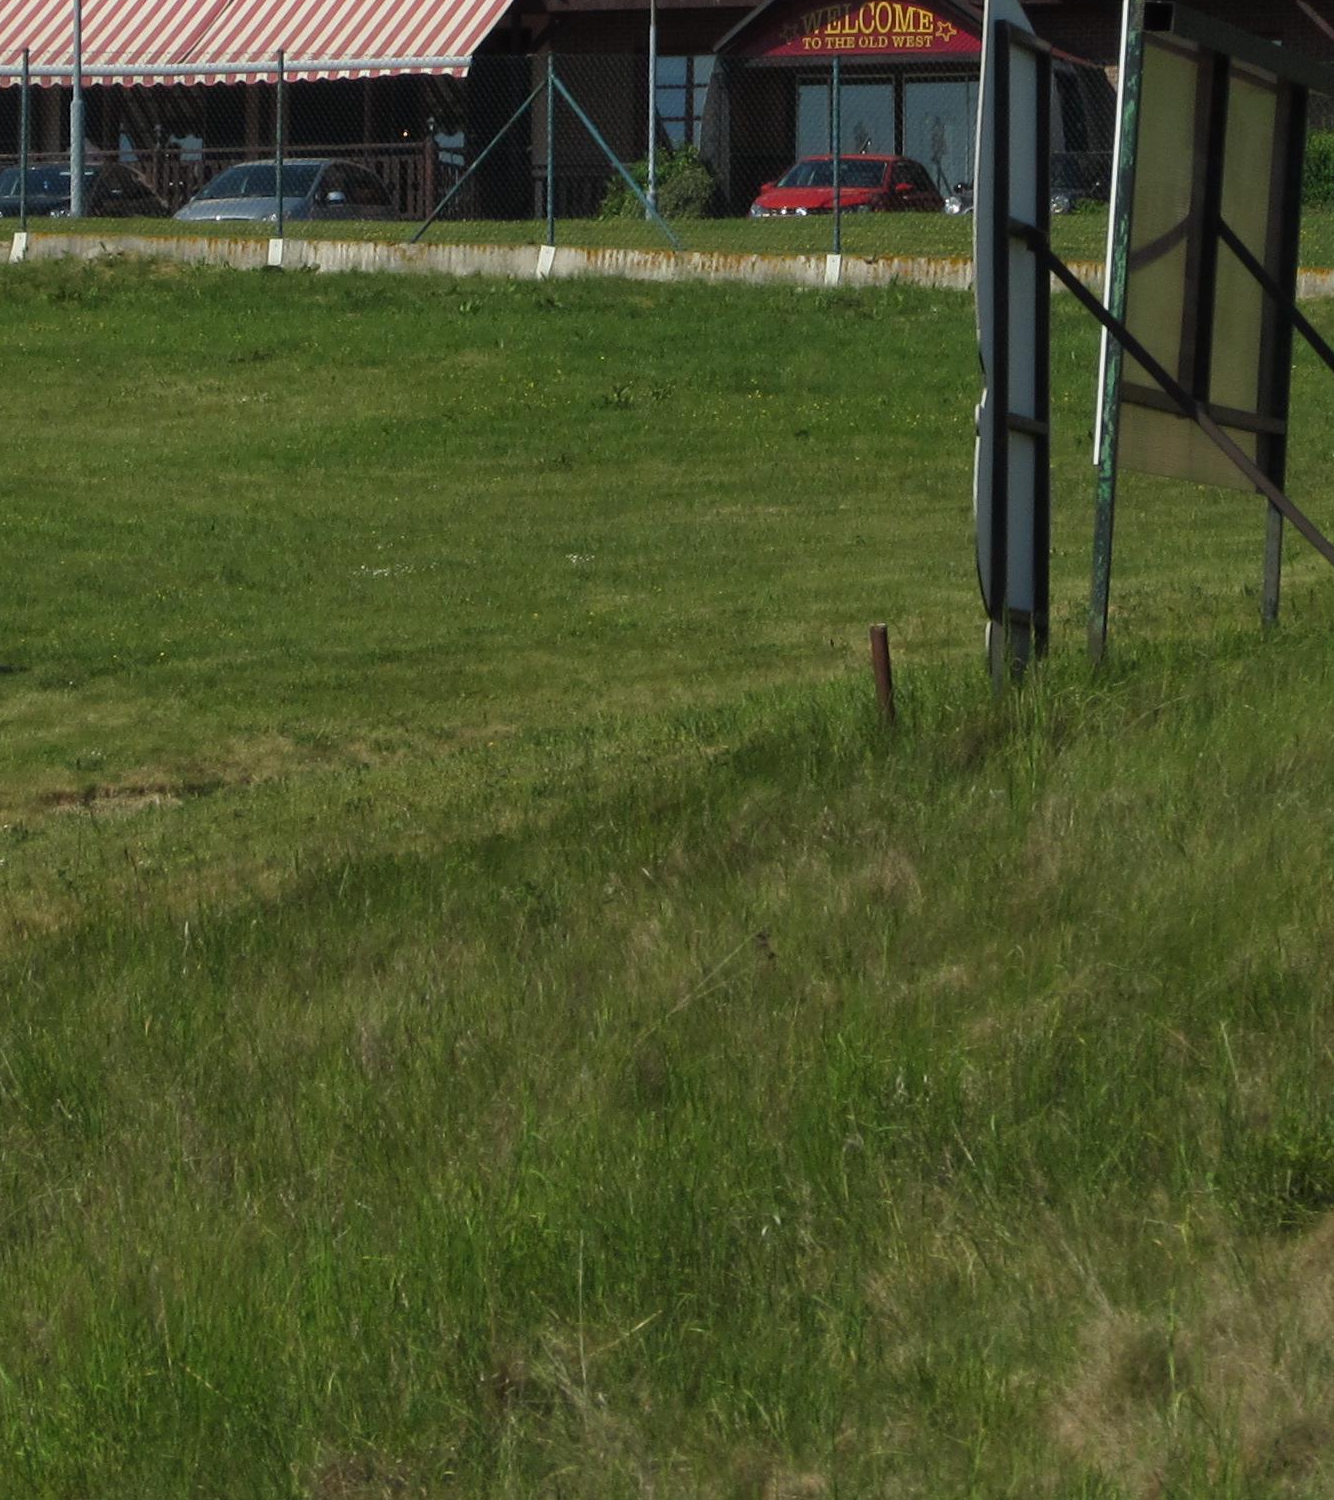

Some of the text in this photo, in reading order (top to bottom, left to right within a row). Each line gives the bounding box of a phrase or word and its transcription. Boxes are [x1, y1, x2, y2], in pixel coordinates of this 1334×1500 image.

[802, 2, 934, 35] WELCOME
[802, 35, 933, 49] TO THE OLD WEST
